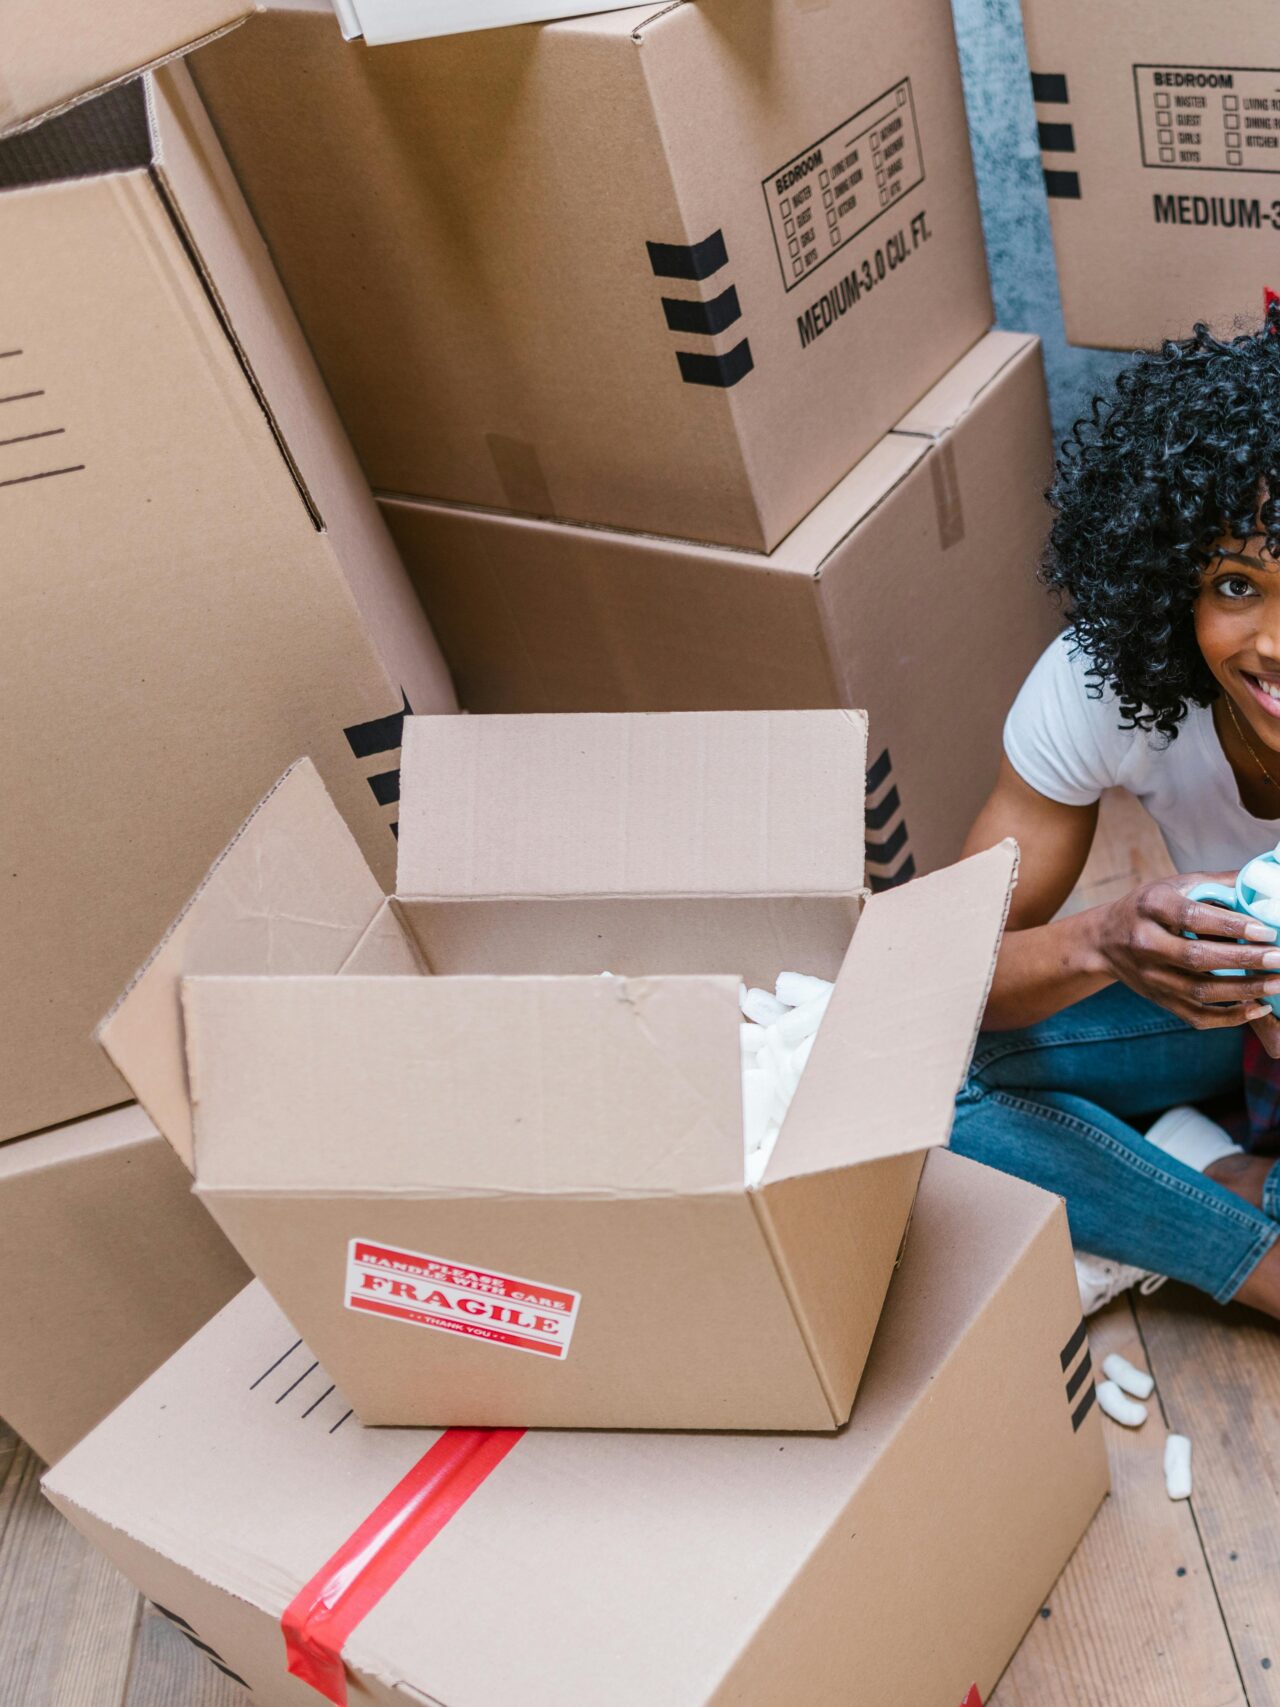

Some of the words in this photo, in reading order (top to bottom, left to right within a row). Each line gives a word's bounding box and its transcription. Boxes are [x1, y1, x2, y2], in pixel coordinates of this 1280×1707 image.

[1153, 72, 1234, 88] BEDROOM
[775, 148, 824, 196] BEDROOM
[796, 248, 887, 350] MEDIUM-3.0
[886, 230, 912, 272] CU.
[910, 210, 932, 249] FT.
[361, 1254, 447, 1282] HANDLE
[452, 1277, 506, 1296] WITH
[511, 1291, 567, 1310] CARE
[427, 1262, 505, 1288] PLEASE
[360, 1273, 560, 1335] FRAGILE
[424, 1317, 465, 1332] THANK
[466, 1325, 491, 1338] YOU
